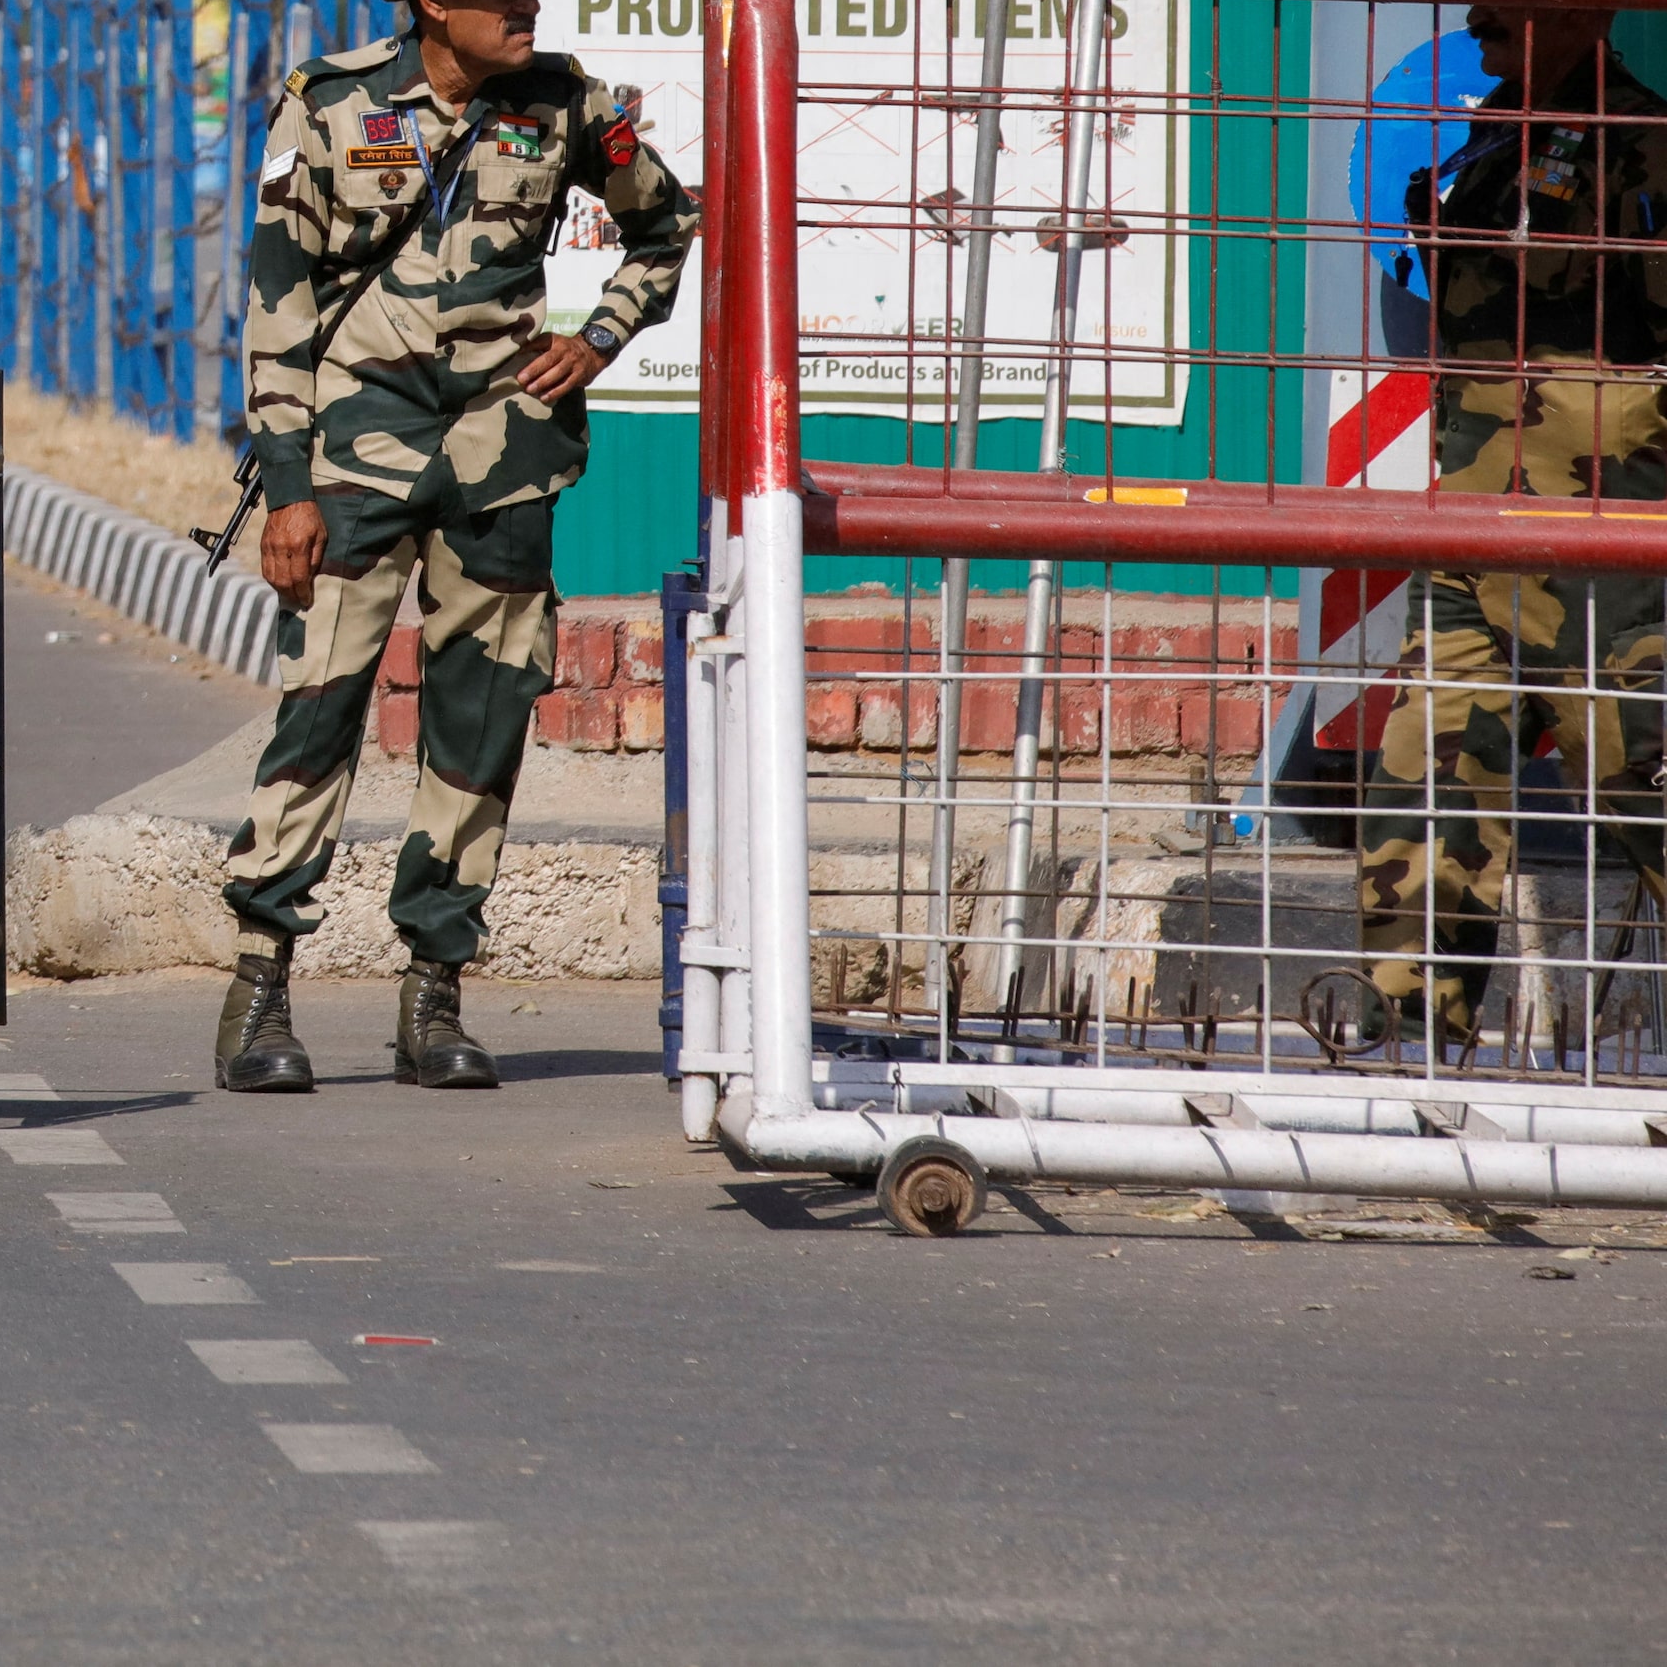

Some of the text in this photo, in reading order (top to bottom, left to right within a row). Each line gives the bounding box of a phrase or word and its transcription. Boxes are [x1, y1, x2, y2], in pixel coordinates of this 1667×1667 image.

[366, 116, 397, 140] BSF
[639, 358, 702, 381] Super
[933, 363, 960, 381] an
